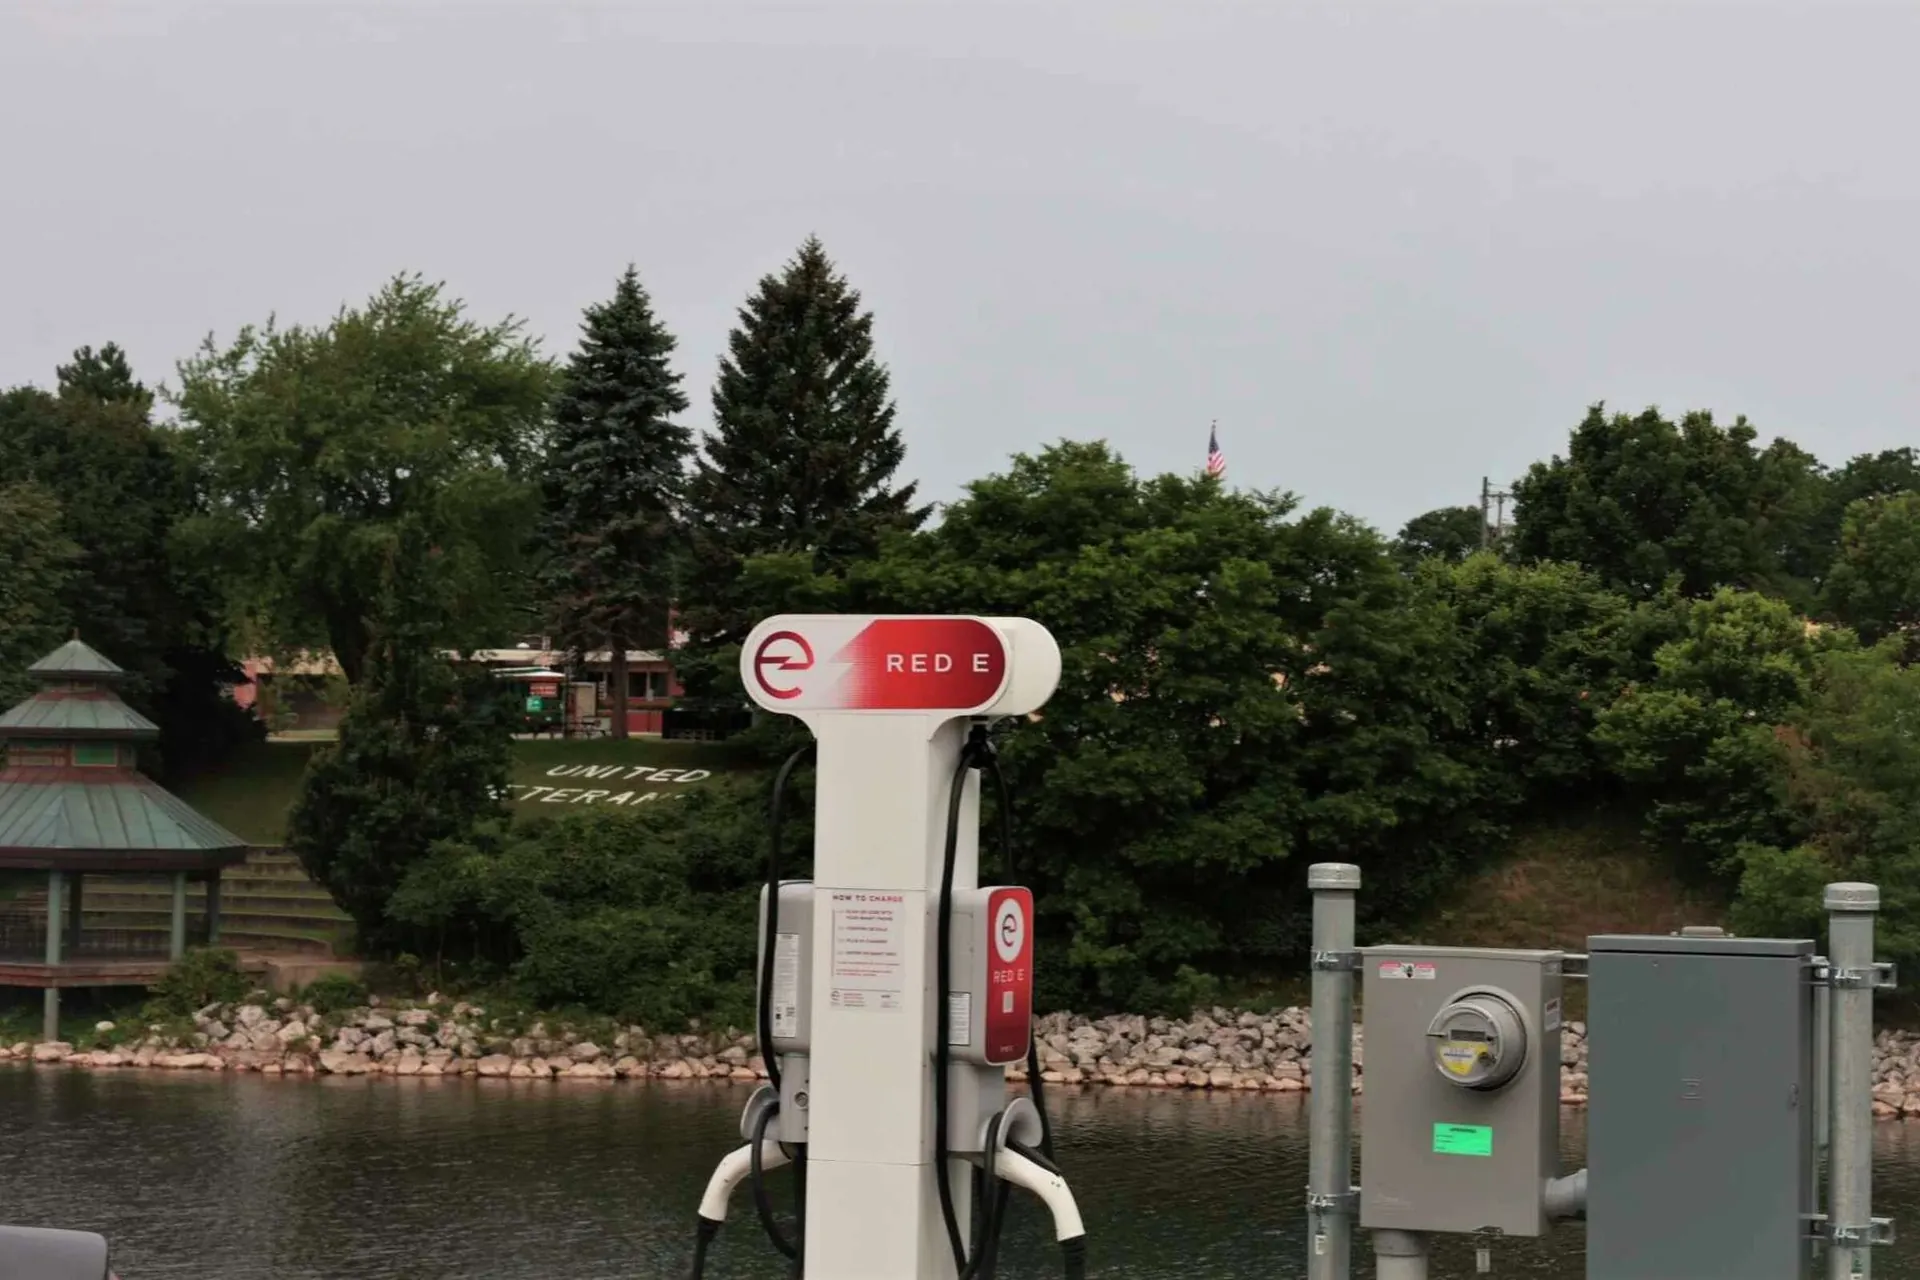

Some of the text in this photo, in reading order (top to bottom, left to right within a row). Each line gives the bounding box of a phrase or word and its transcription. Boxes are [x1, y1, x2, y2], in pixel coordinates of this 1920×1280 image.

[886, 653, 990, 673] RED E
[546, 764, 711, 783] UNITED
[993, 968, 1025, 985] RED E
